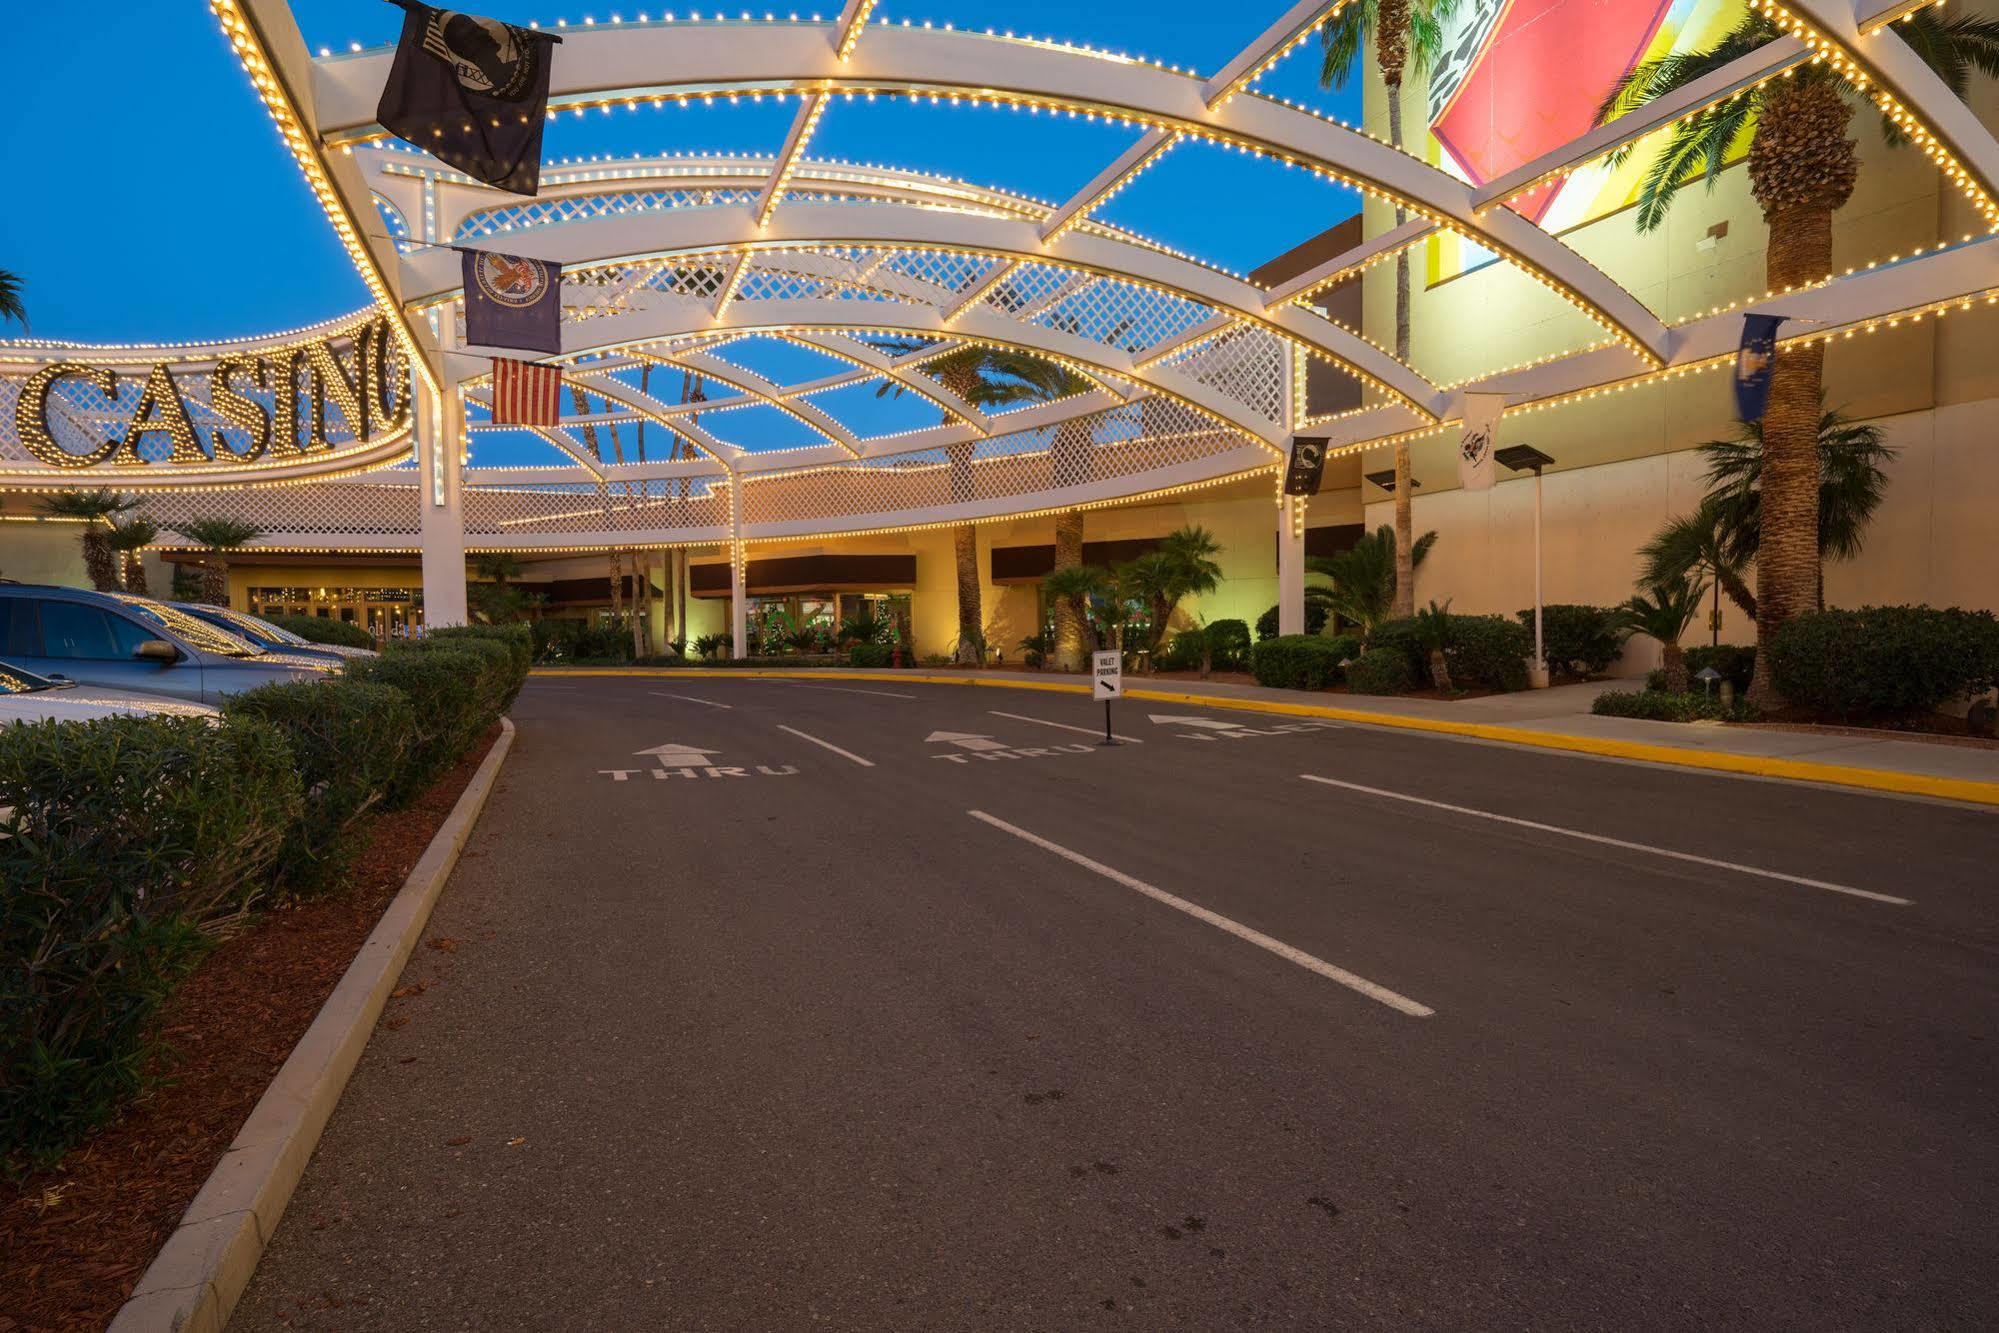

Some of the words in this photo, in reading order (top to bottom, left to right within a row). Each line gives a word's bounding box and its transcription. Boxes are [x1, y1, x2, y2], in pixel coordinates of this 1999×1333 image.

[15, 316, 413, 468] CASINO
[1099, 657, 1115, 666] VALET
[1096, 667, 1118, 677] PARKING
[929, 744, 1097, 763] THRU
[597, 764, 801, 781] THRU
